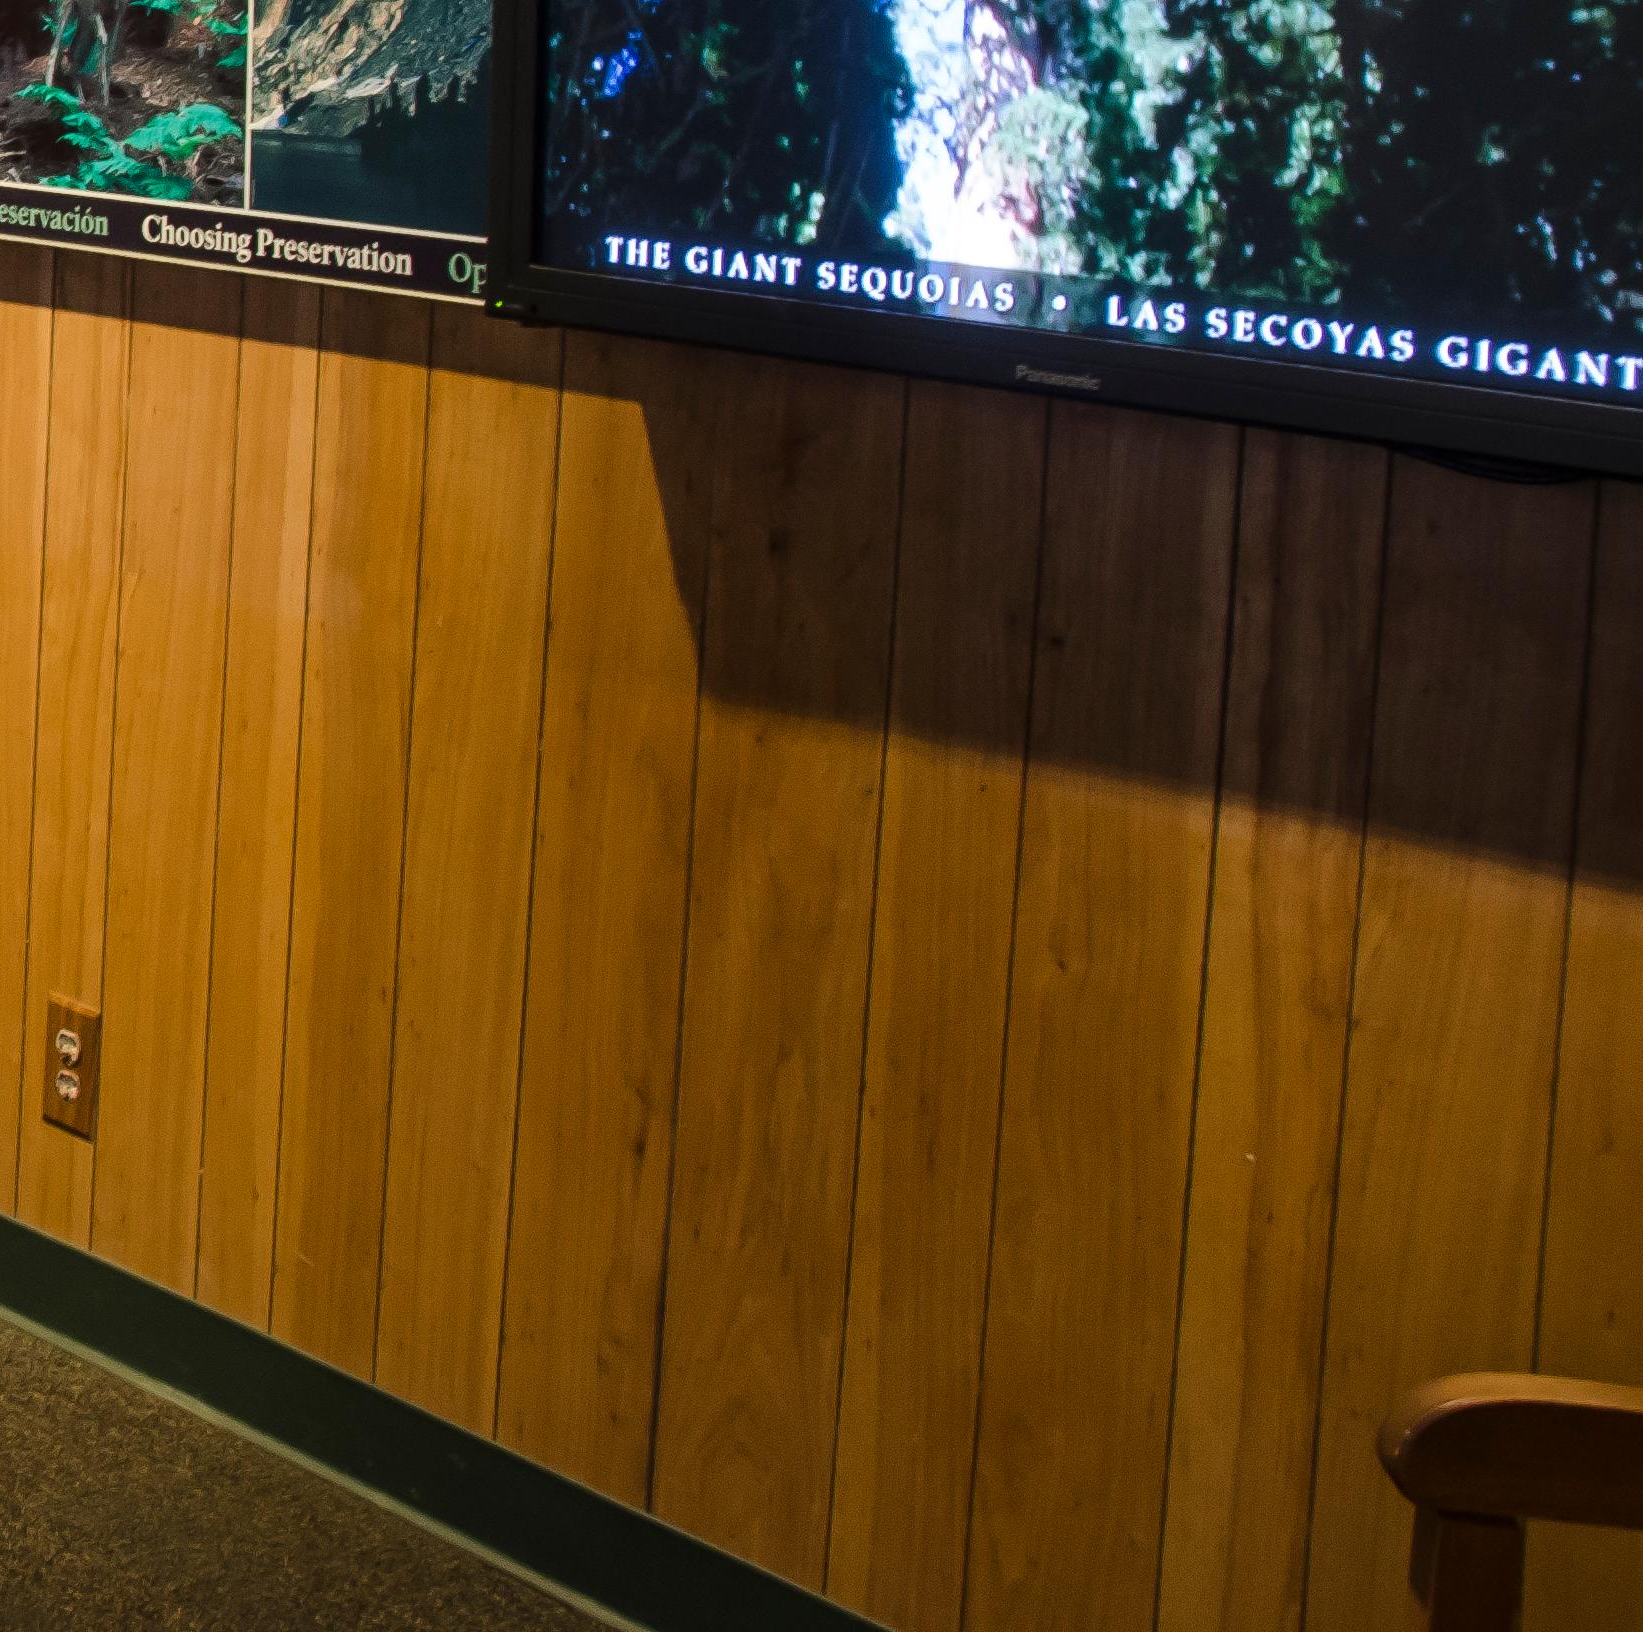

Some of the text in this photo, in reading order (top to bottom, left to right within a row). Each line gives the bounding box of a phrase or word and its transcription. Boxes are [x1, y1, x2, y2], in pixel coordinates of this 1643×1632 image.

[141, 214, 413, 276] Choosing Preservation
[605, 236, 1015, 312] THE GIANT SEQUOIAS
[1107, 294, 1643, 391] LAS SECOYAS GIGANT
[1015, 366, 1101, 392] Panasonic
